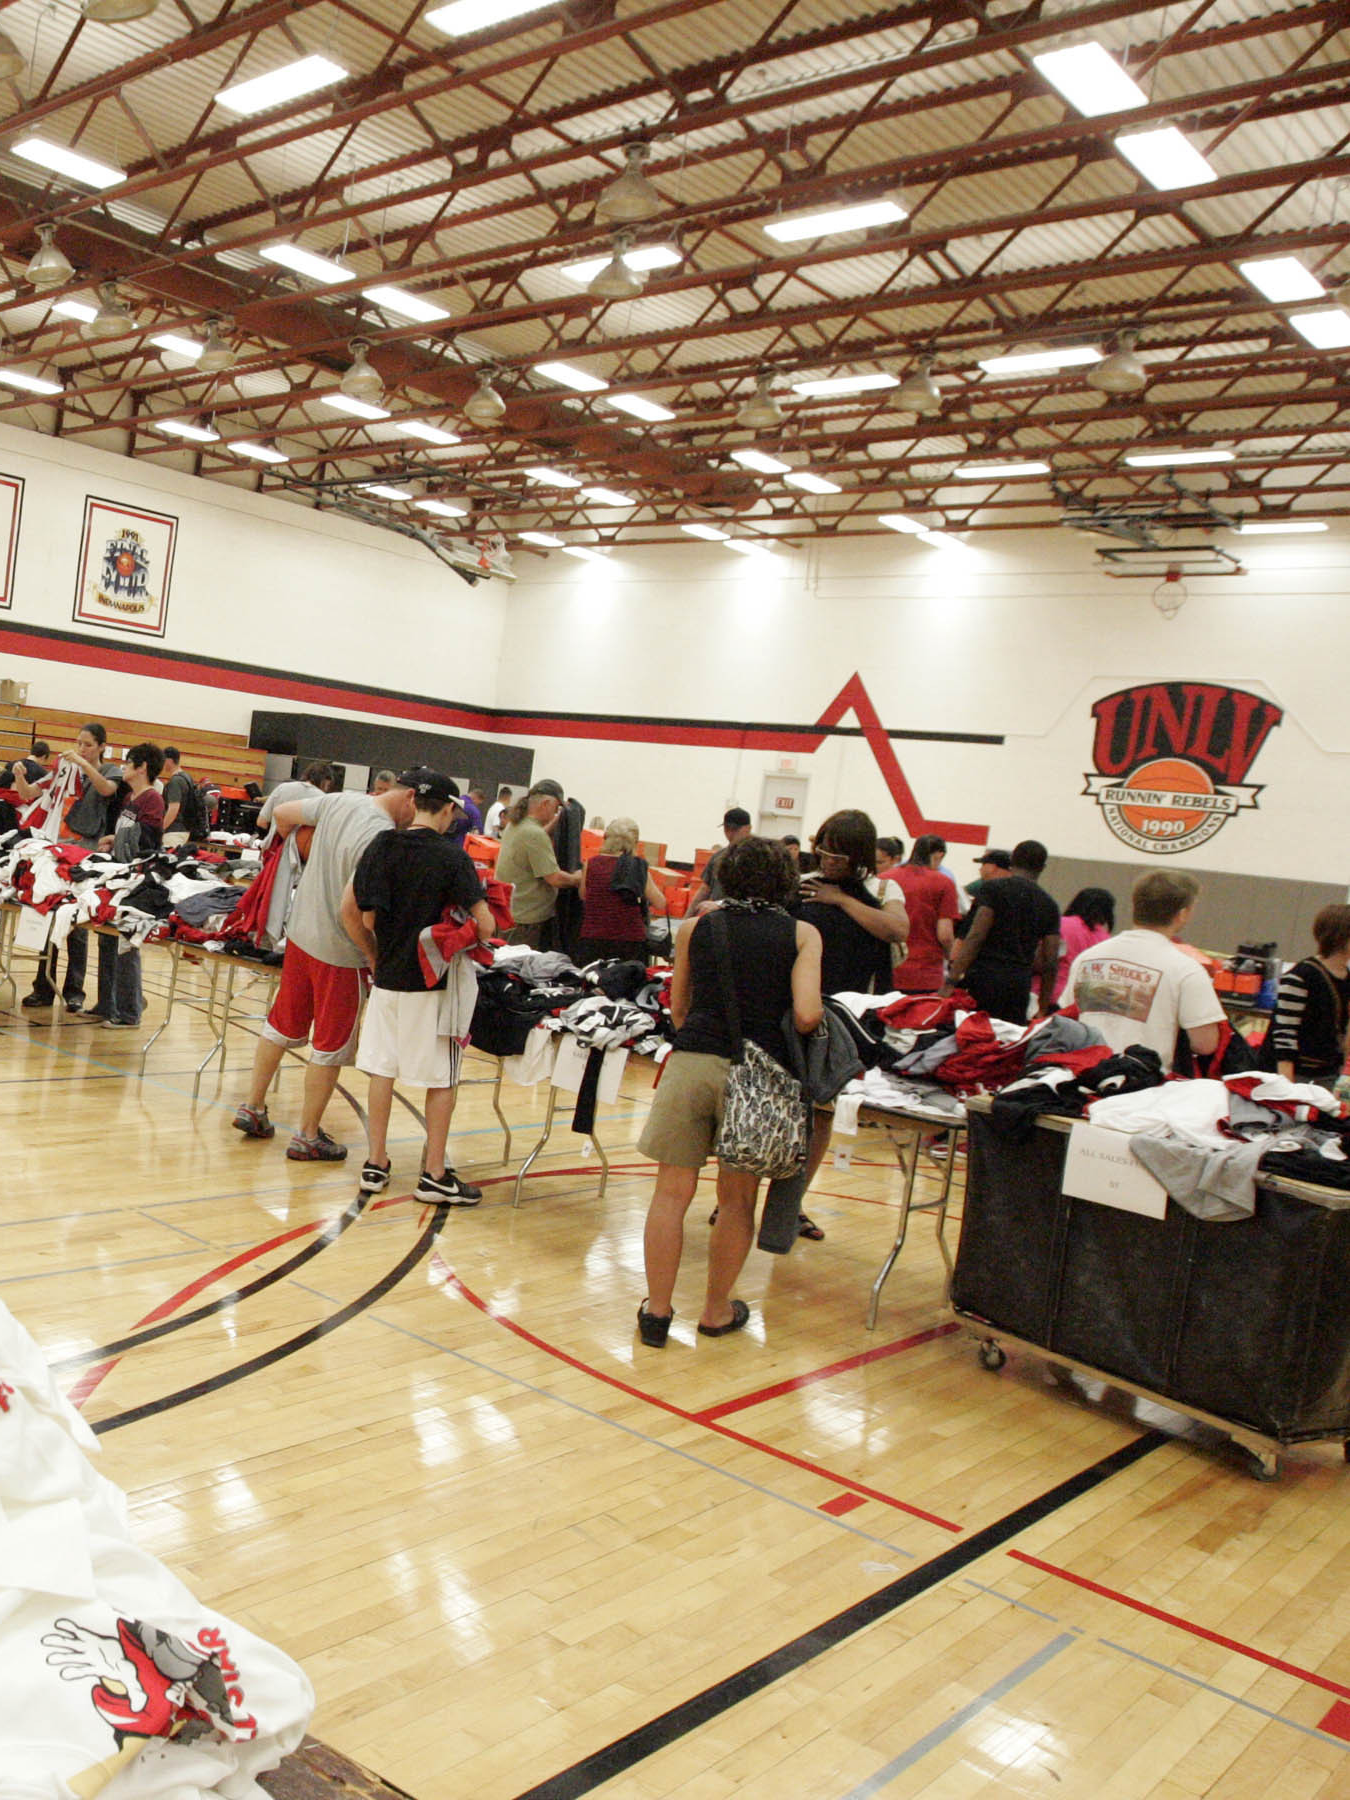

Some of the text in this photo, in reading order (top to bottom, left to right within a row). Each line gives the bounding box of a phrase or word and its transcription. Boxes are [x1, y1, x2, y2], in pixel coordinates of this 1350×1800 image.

[121, 528, 139, 542] 1991
[1092, 682, 1284, 785] UNLV
[1105, 789, 1231, 811] RUNNIN' REBELS
[1107, 806, 1222, 851] NATIONAL CHAMPIONS
[1141, 818, 1186, 838] 1990
